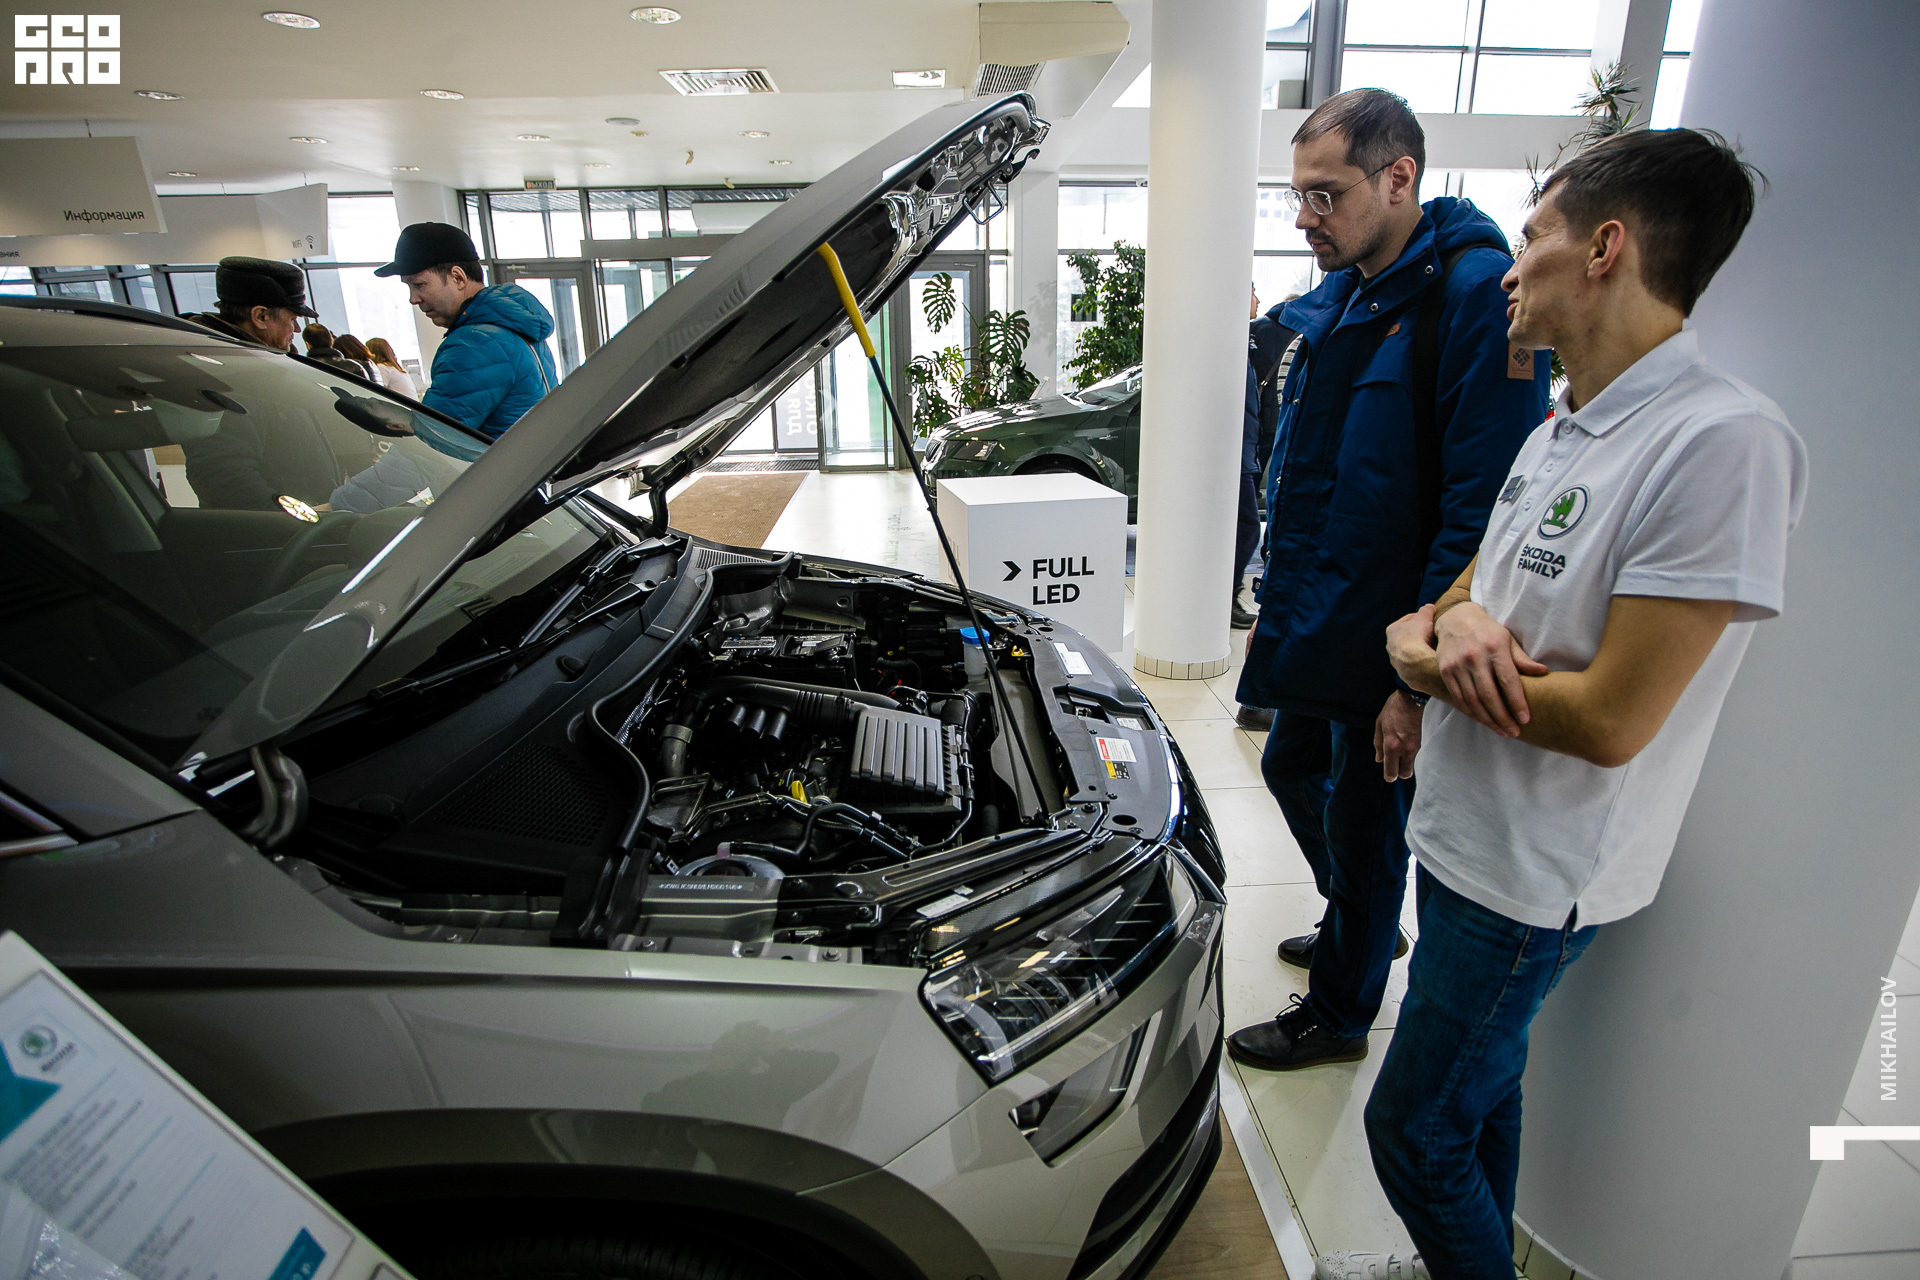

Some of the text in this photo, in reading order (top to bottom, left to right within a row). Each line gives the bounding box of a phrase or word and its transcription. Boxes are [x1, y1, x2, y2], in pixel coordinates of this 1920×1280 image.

[63, 208, 145, 223] Информация
[1521, 543, 1566, 568] ŠKODA
[1032, 556, 1095, 579] FULL
[1517, 557, 1564, 579] FAMILY
[1032, 583, 1080, 605] LED
